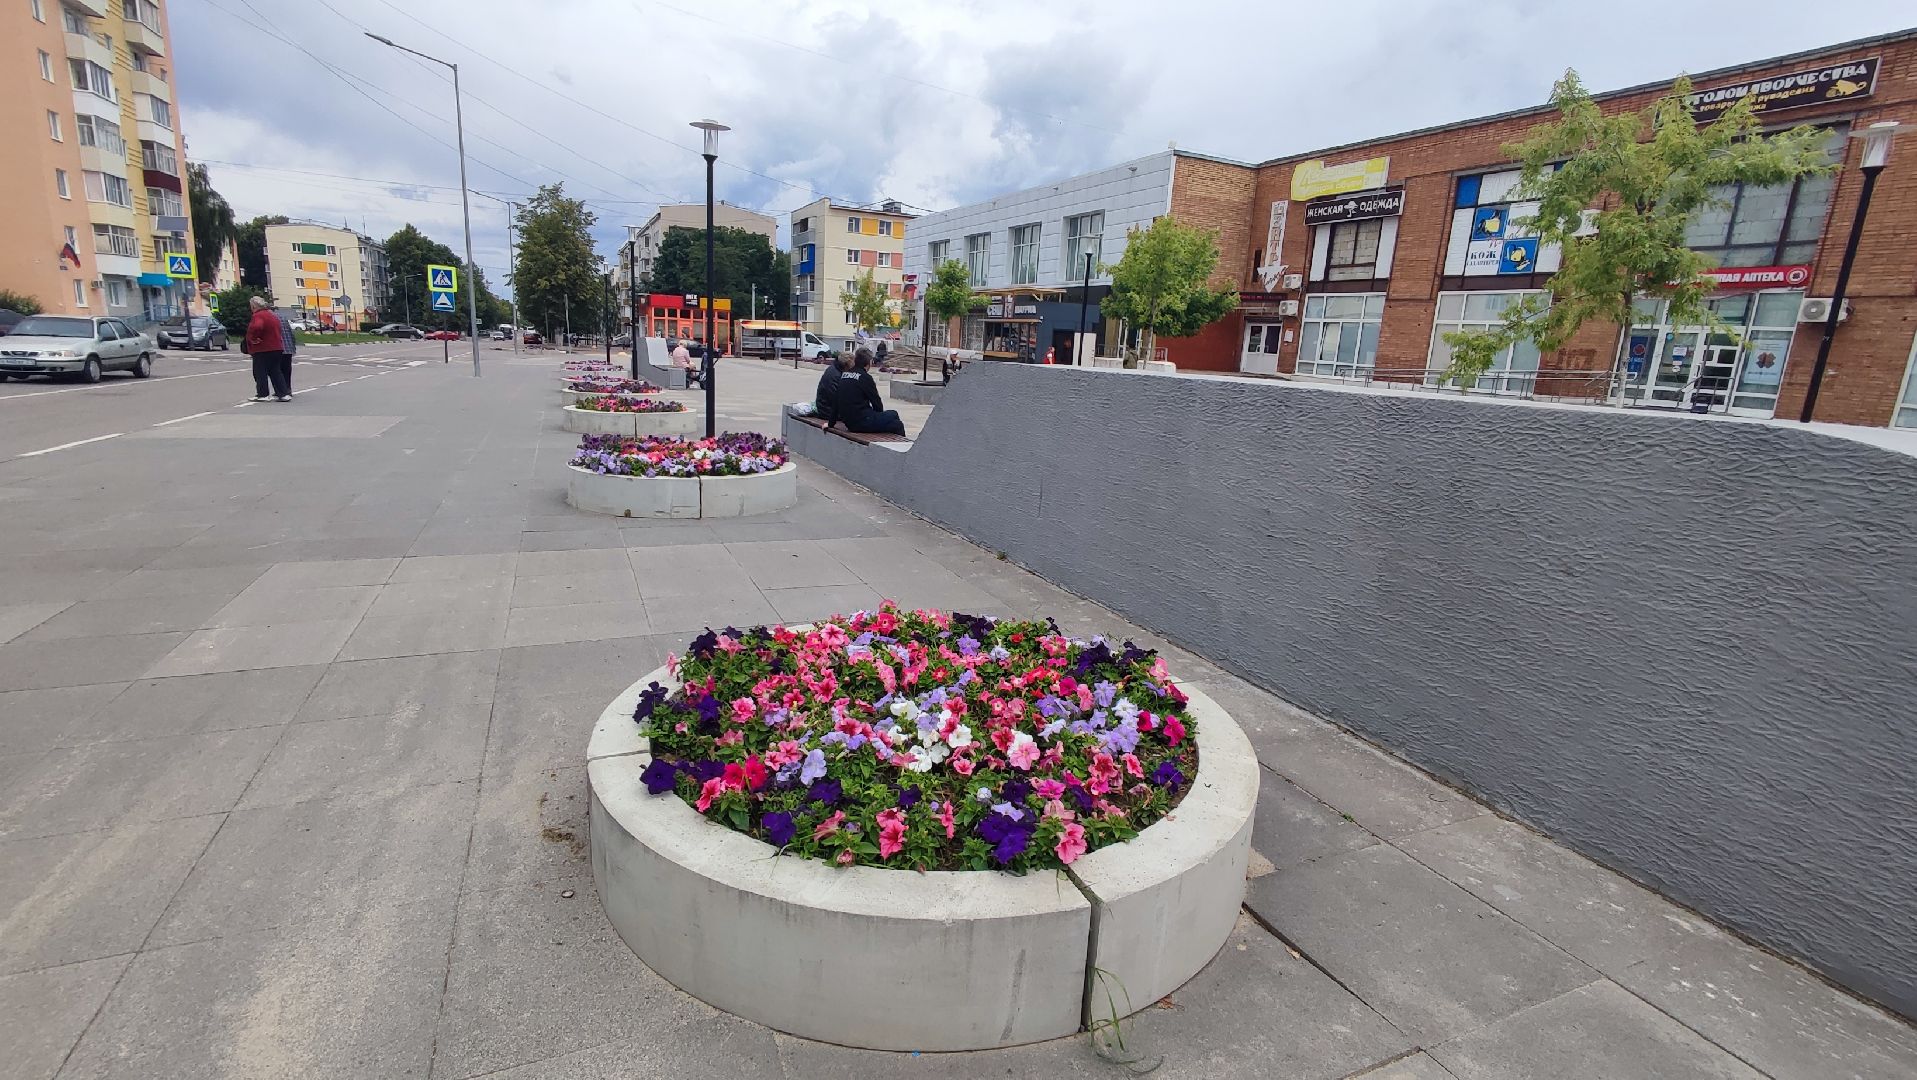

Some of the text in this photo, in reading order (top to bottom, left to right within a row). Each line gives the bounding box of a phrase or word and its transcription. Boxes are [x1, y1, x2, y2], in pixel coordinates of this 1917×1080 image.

[1306, 197, 1400, 218] ЖЕНСКАЯ ОДЕЖДА
[1741, 271, 1785, 283] АПТЕКА
